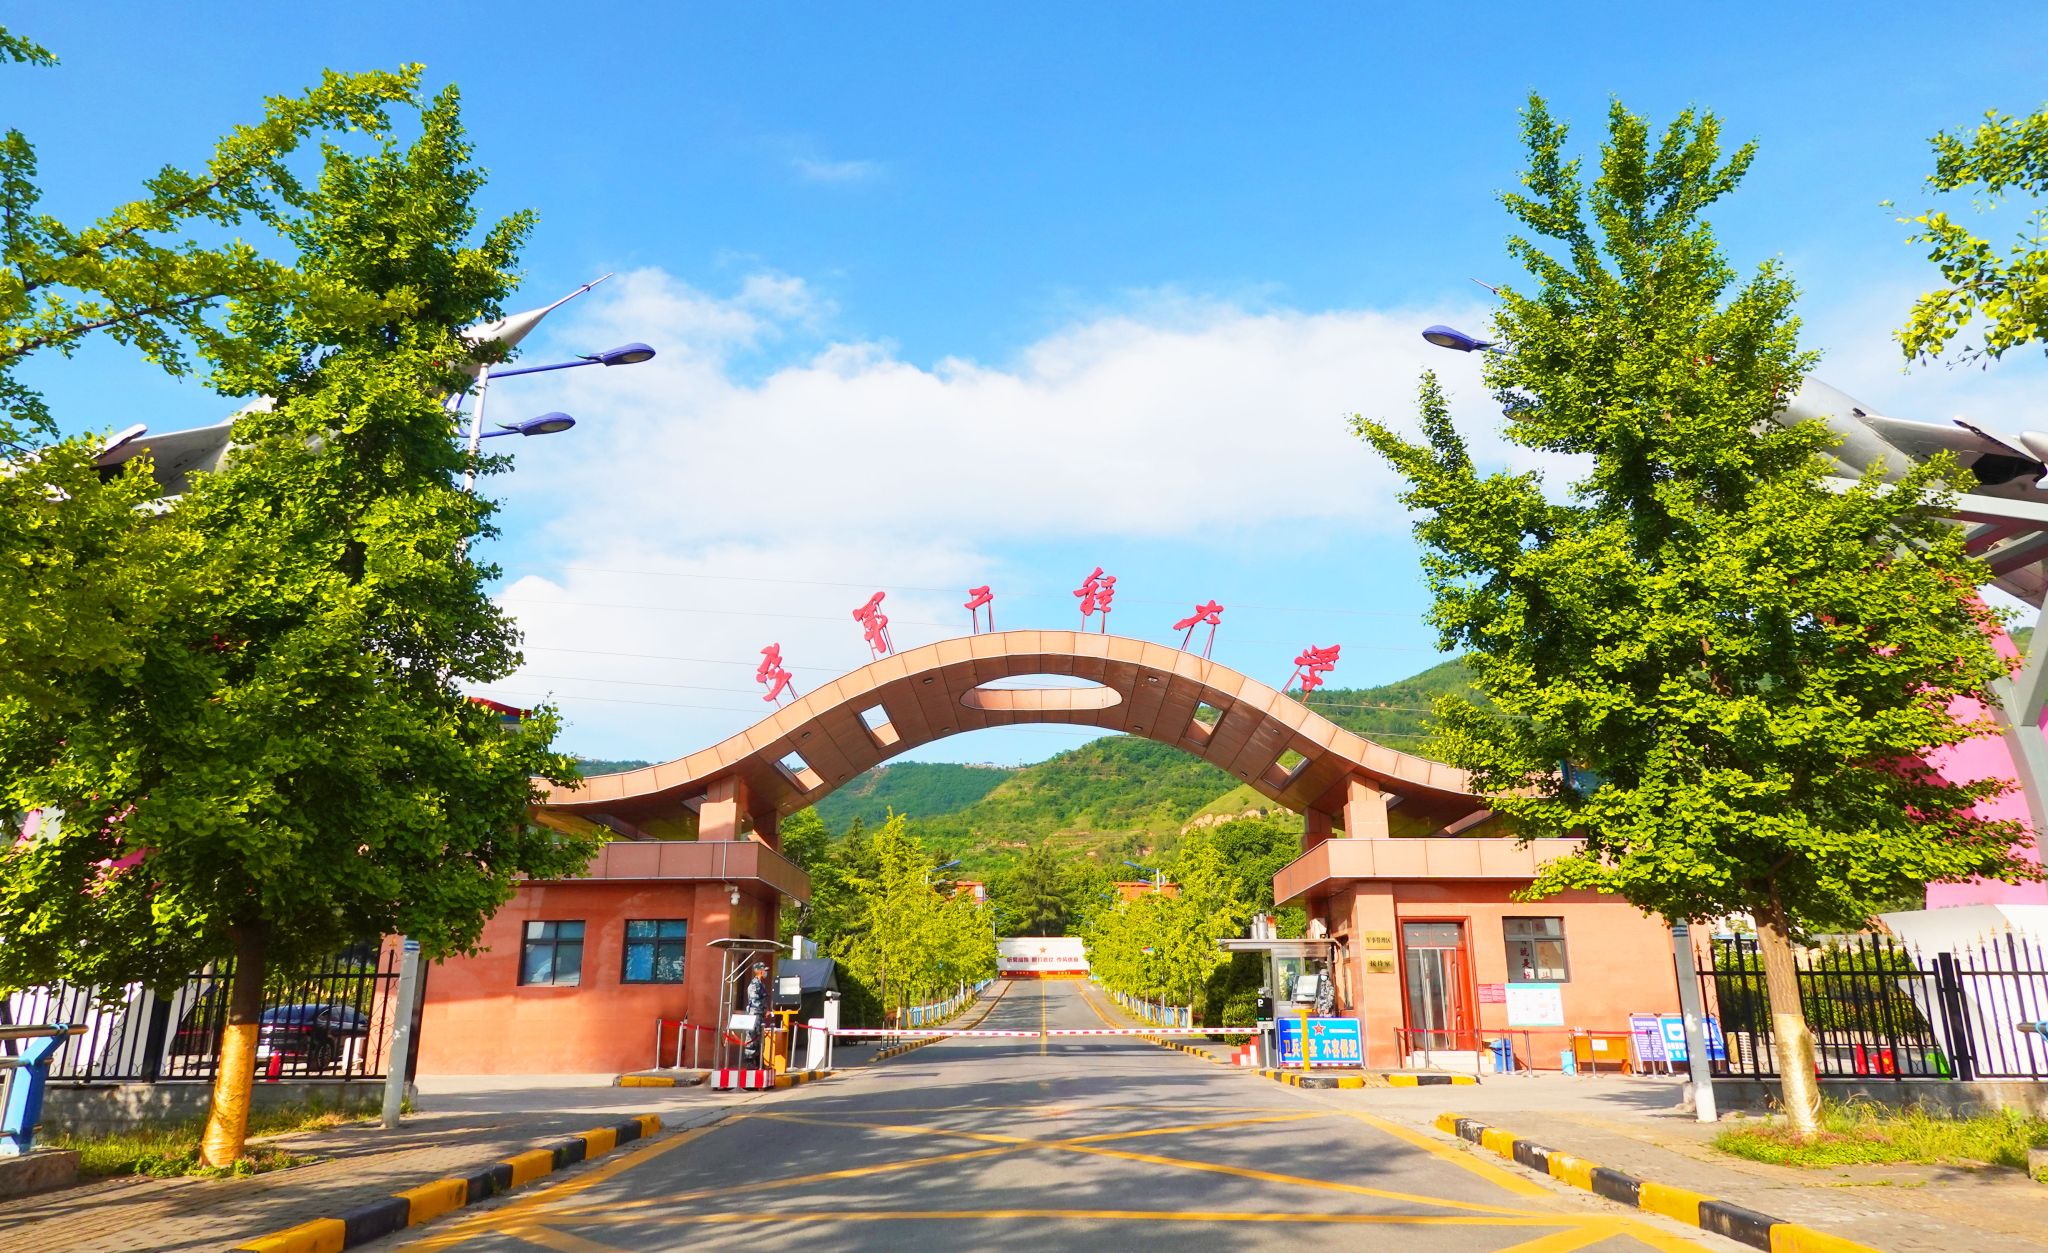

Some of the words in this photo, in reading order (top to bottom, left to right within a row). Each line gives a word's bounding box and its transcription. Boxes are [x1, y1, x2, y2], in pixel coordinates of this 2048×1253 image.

[756, 567, 1341, 702] 空军工程大学
[1283, 1038, 1318, 1058] 卫兵圣
[1322, 1038, 1358, 1059] 不容侵犯
